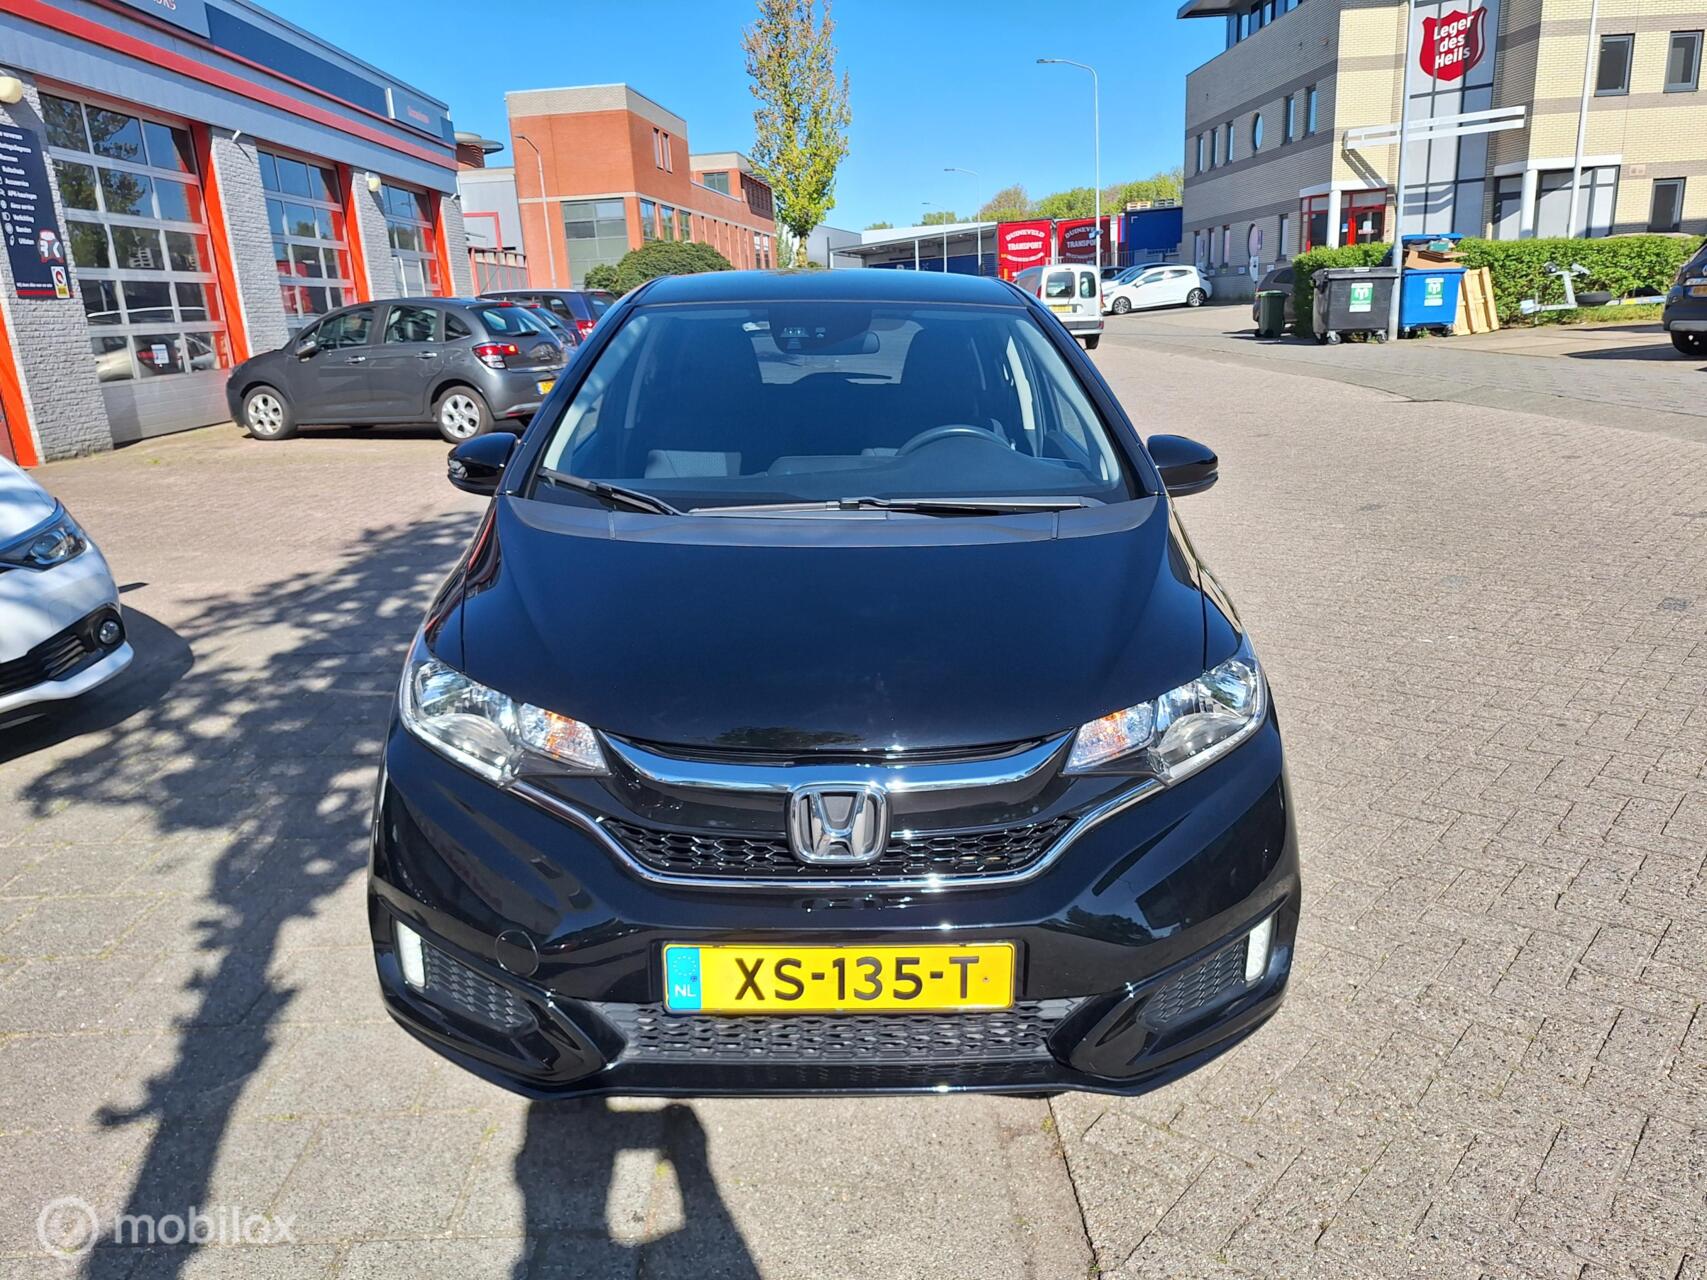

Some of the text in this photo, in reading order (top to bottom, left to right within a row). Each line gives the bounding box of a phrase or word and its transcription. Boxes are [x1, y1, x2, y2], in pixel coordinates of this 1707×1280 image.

[1433, 15, 1474, 40] Leger
[1440, 34, 1465, 52] des
[1434, 47, 1470, 69] Heils
[1008, 241, 1042, 251] TRANSPORT
[735, 956, 979, 1001] XS-135-T
[674, 984, 696, 998] NL
